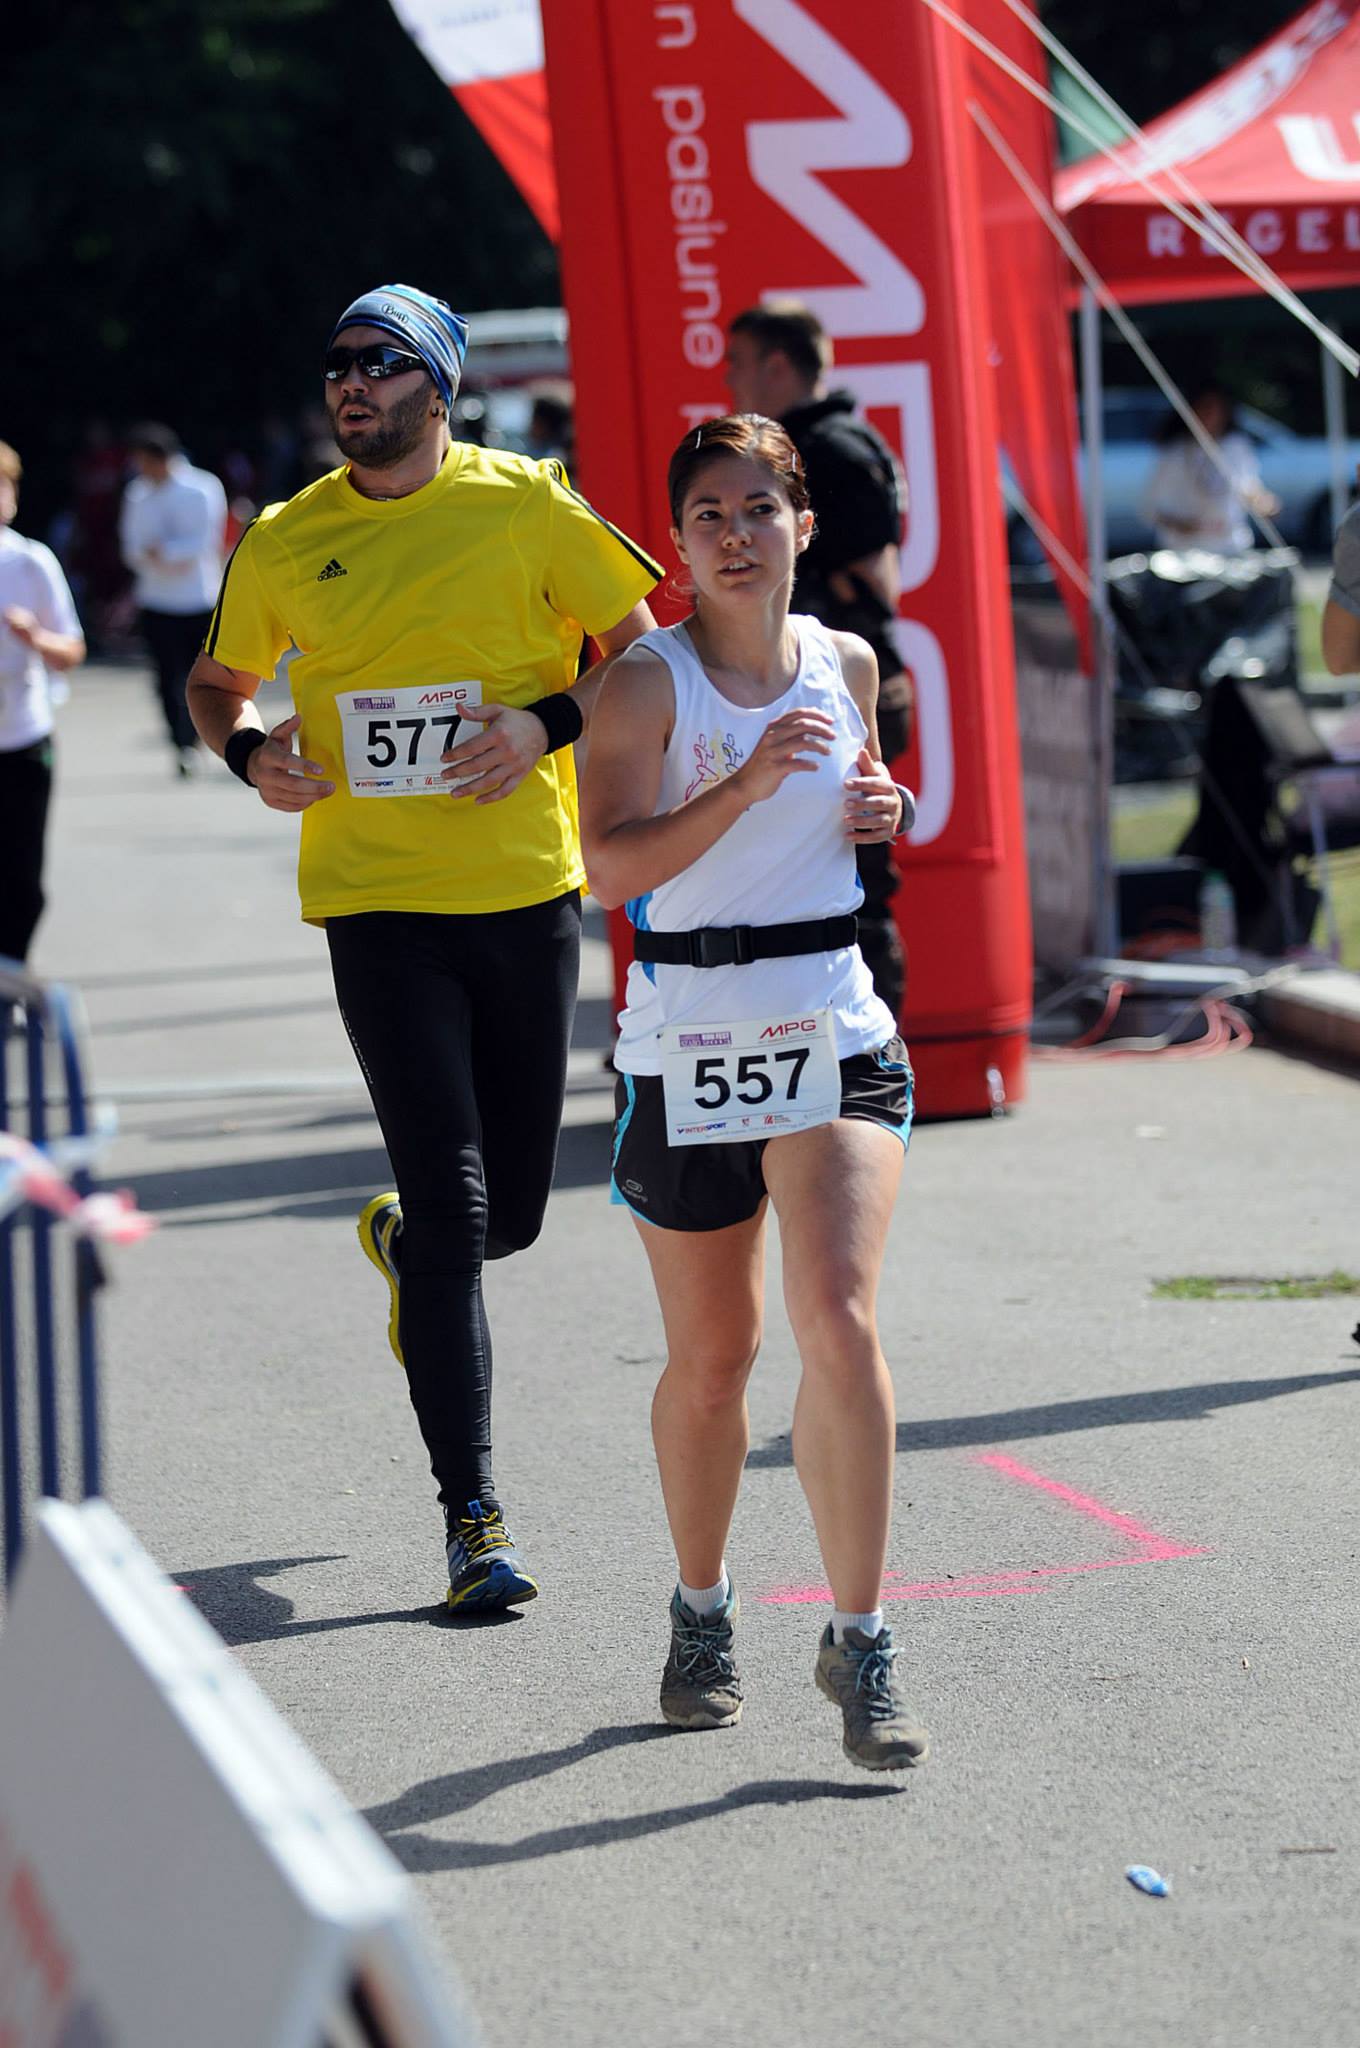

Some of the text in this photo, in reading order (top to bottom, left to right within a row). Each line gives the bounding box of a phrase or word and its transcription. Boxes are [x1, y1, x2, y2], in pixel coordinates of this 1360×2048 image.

[652, 84, 728, 369] pasiune
[417, 688, 467, 705] MPG
[366, 714, 463, 768] 577
[759, 1019, 817, 1040] MPG
[694, 1047, 810, 1110] 557
